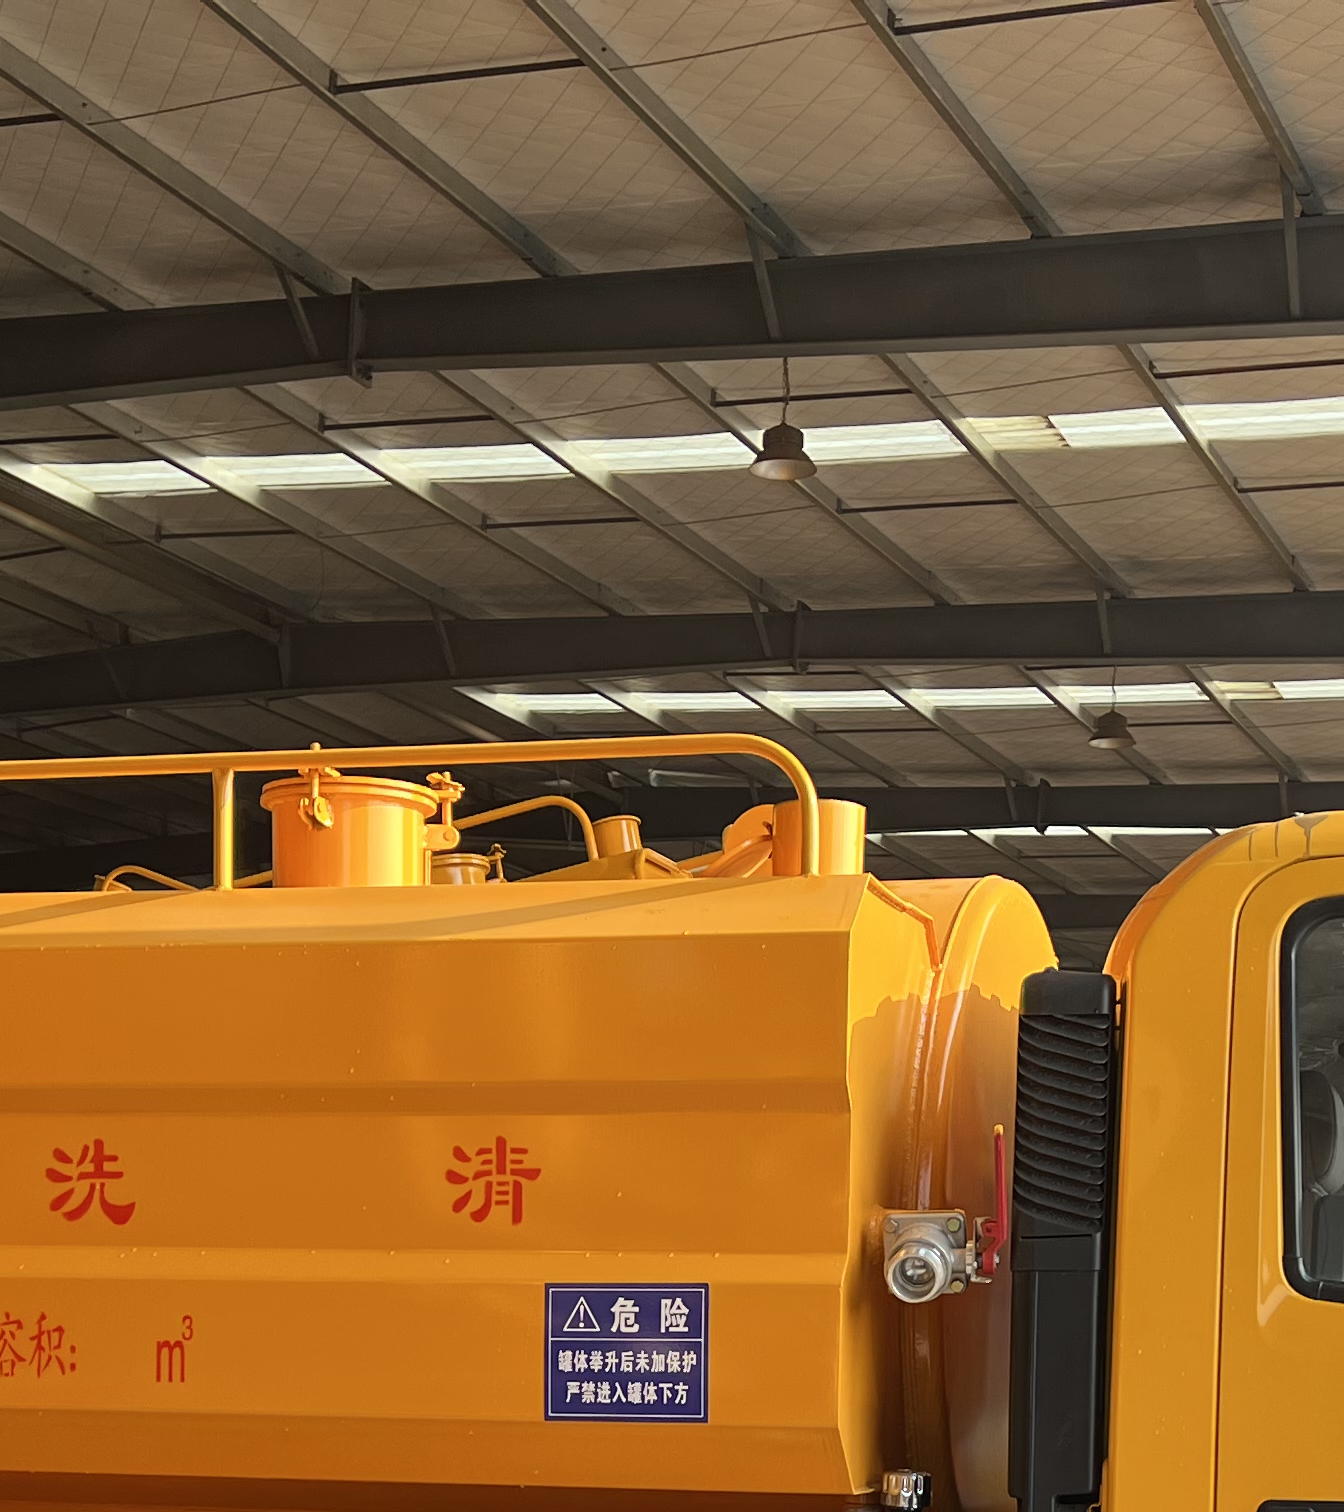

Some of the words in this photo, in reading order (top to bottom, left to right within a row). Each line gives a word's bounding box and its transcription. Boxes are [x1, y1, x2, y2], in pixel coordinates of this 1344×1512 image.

[46, 1139, 136, 1226] 洗
[445, 1136, 542, 1225] 清
[610, 1296, 689, 1333] 危险
[558, 1348, 697, 1375] 罐体举升后未加保护
[565, 1379, 689, 1406] 严禁进入罐体下方
